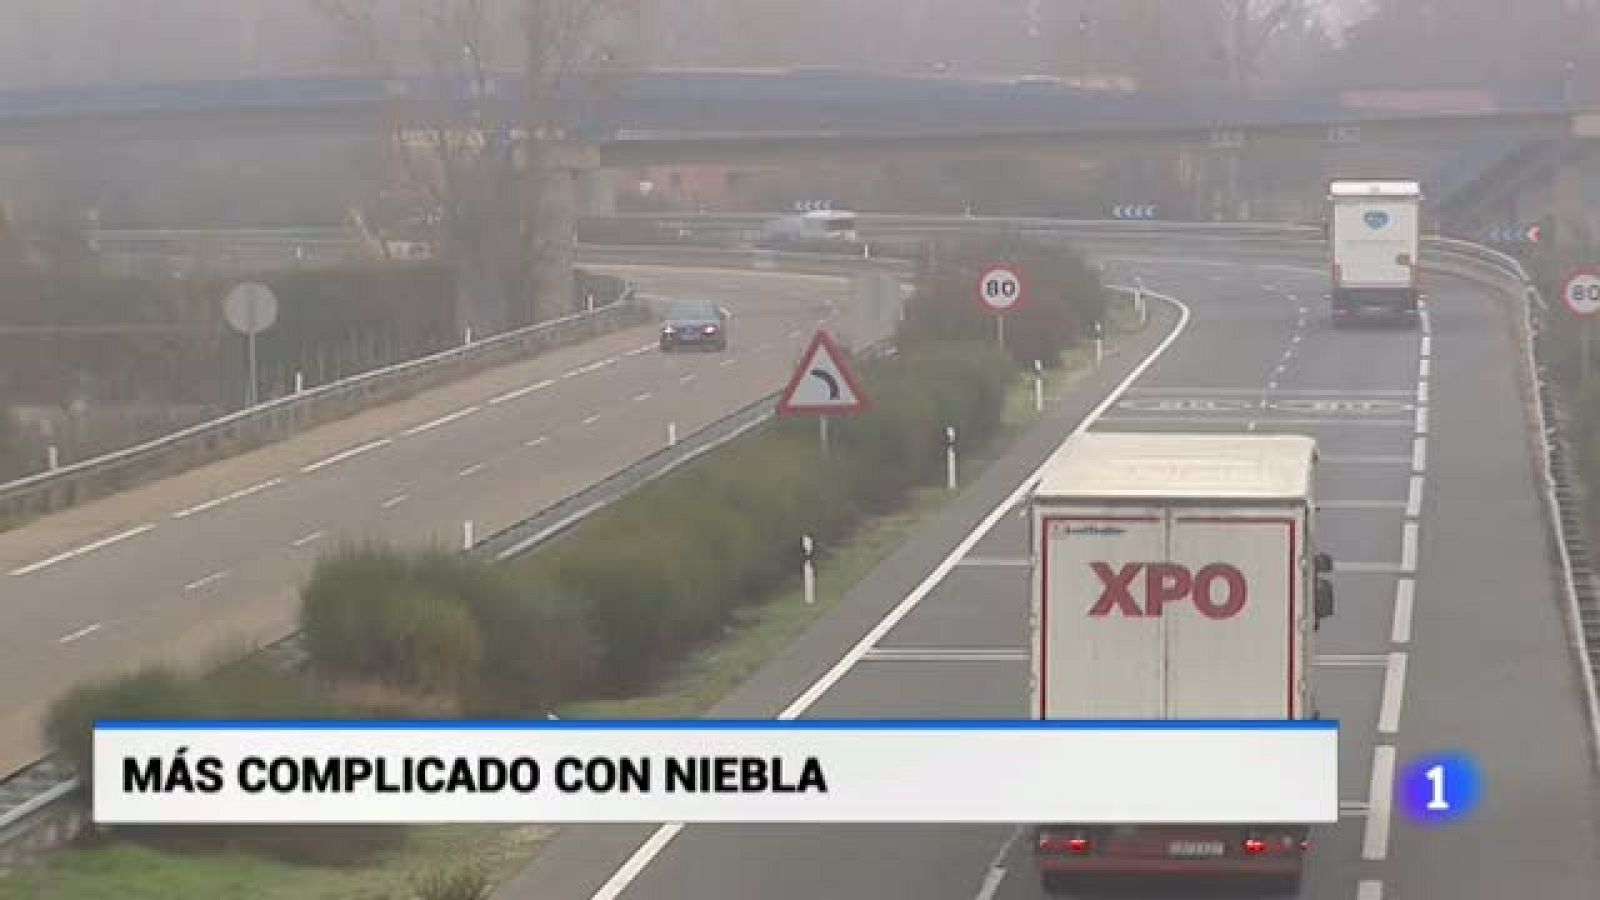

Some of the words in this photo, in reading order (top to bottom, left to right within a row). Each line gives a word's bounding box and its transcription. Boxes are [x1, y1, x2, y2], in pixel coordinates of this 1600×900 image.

[986, 279, 1016, 297] 80
[1572, 284, 1600, 301] 80
[1088, 561, 1247, 620] XPO
